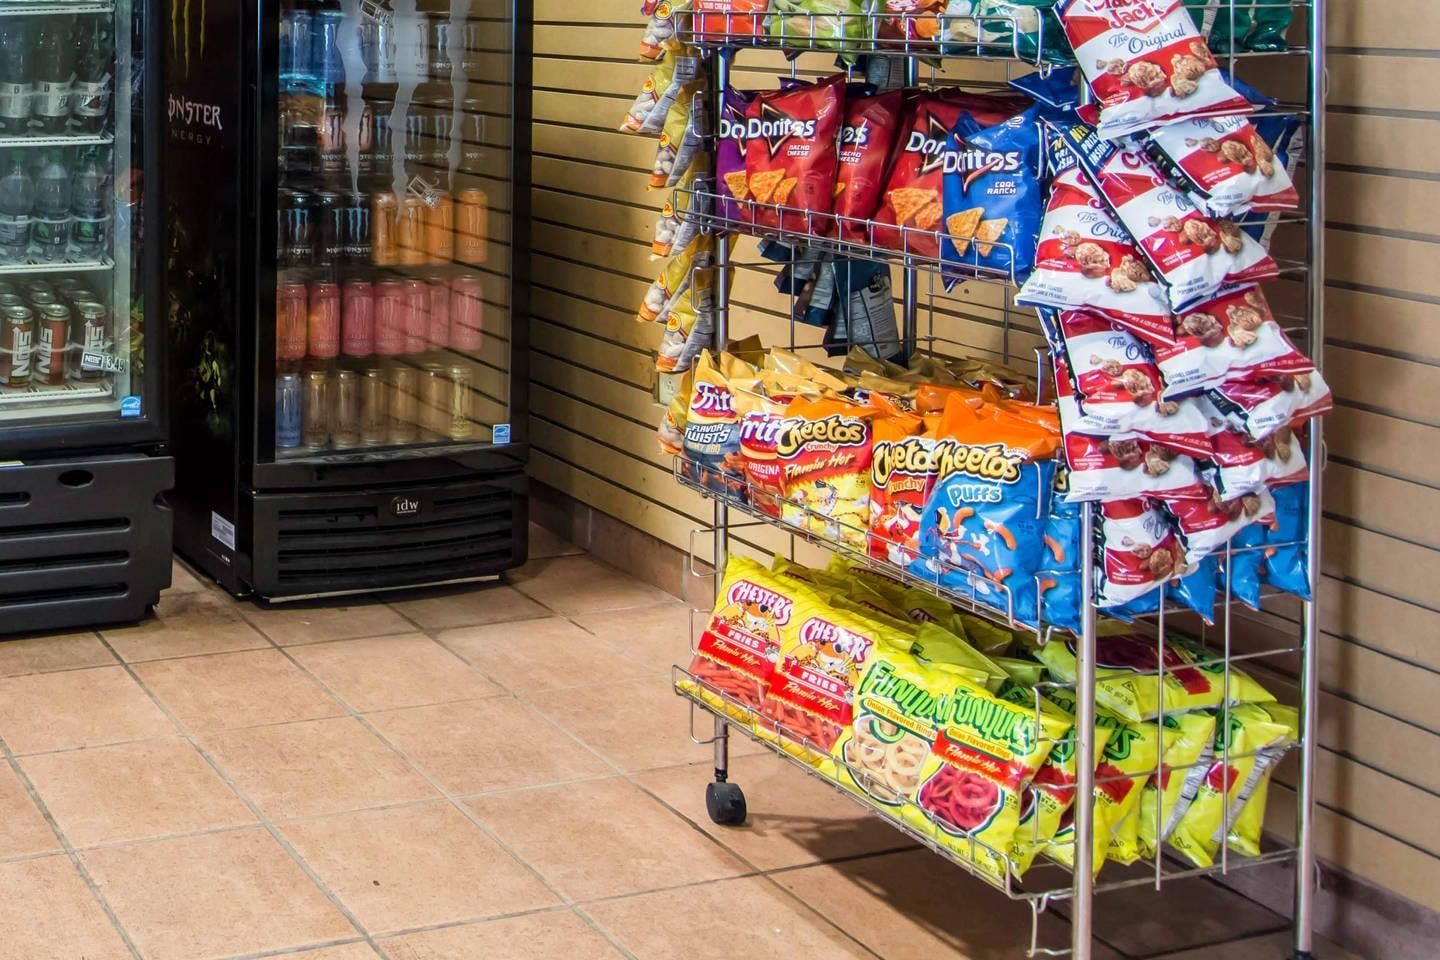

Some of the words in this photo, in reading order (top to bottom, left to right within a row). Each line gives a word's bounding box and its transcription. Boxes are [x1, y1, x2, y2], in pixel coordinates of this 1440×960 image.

[1109, 2, 1164, 29] Jack
[1108, 33, 1129, 48] The
[1128, 24, 1186, 54] Original
[168, 93, 222, 130] ONSTER
[171, 129, 212, 144] NERGY
[747, 117, 815, 139] Doritos
[943, 149, 1019, 174] Doritos
[685, 428, 730, 444] TWISTS
[692, 424, 723, 433] FLAVOR
[776, 416, 862, 457] Cheetos
[805, 442, 837, 453] Crunchy
[748, 461, 781, 475] ORIGINA
[827, 452, 856, 467] Hot
[947, 484, 1002, 505] Puffs
[727, 629, 760, 649] FRIES
[801, 670, 838, 692] FRIES
[861, 661, 949, 725] FUNYUN
[866, 698, 885, 714] Onion
[885, 705, 914, 728] Flavored
